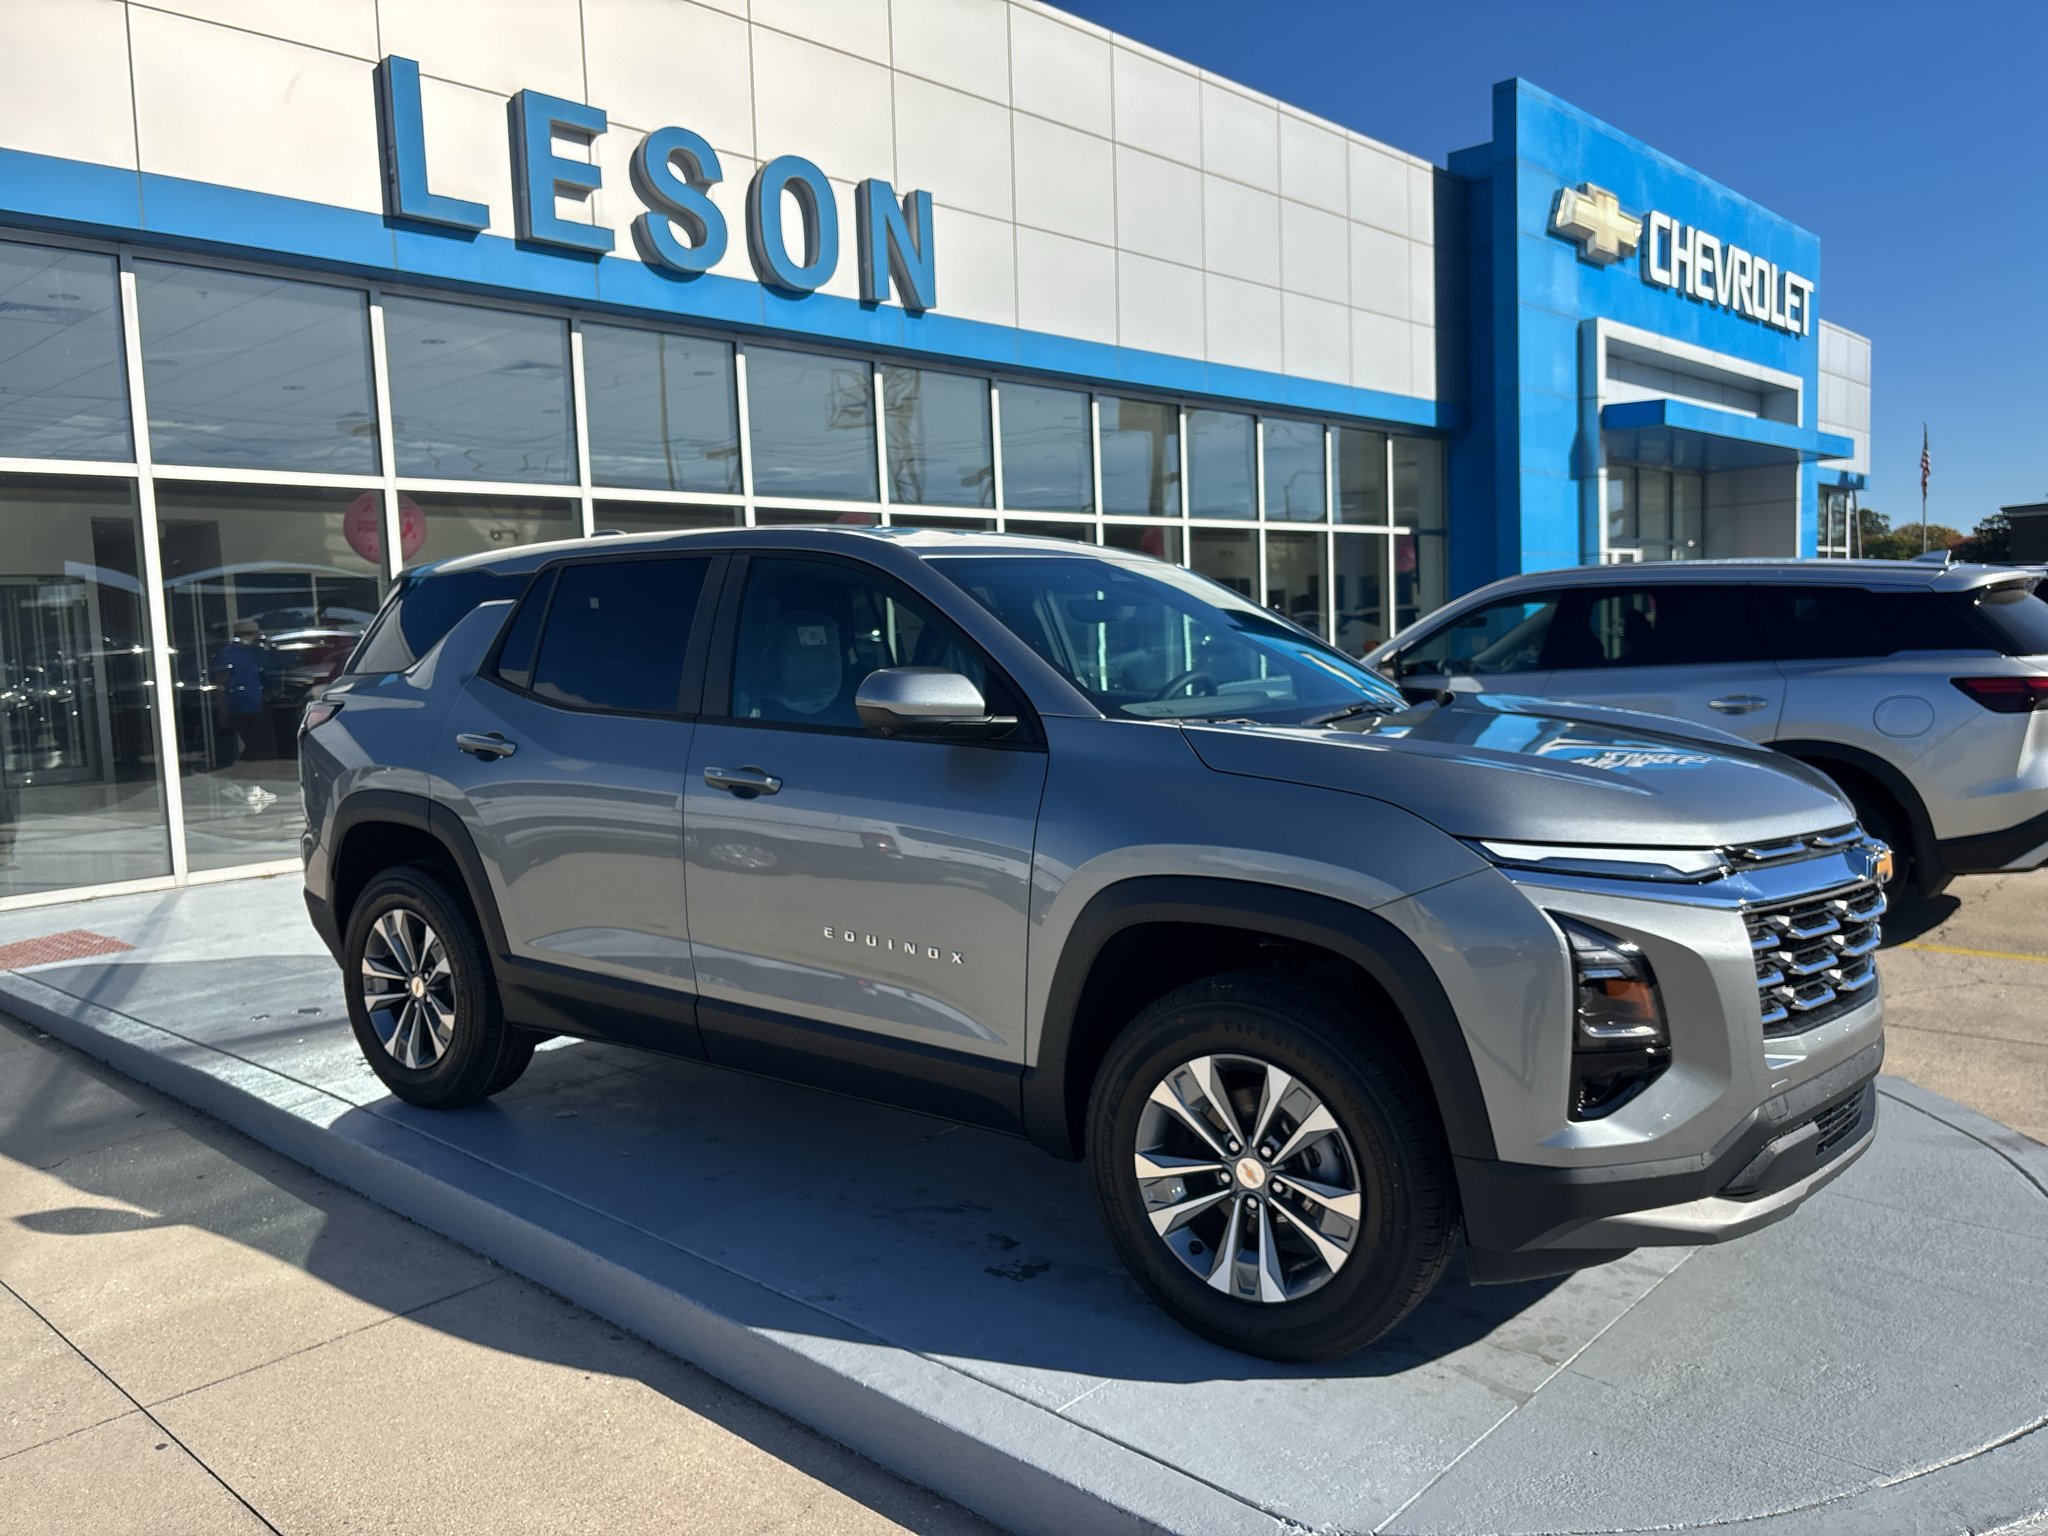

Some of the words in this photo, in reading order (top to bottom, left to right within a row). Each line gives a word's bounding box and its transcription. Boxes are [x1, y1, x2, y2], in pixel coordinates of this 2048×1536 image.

[373, 54, 938, 311] LESON
[1645, 209, 1814, 337] CHEVROLET
[823, 926, 965, 965] EQUINOX
